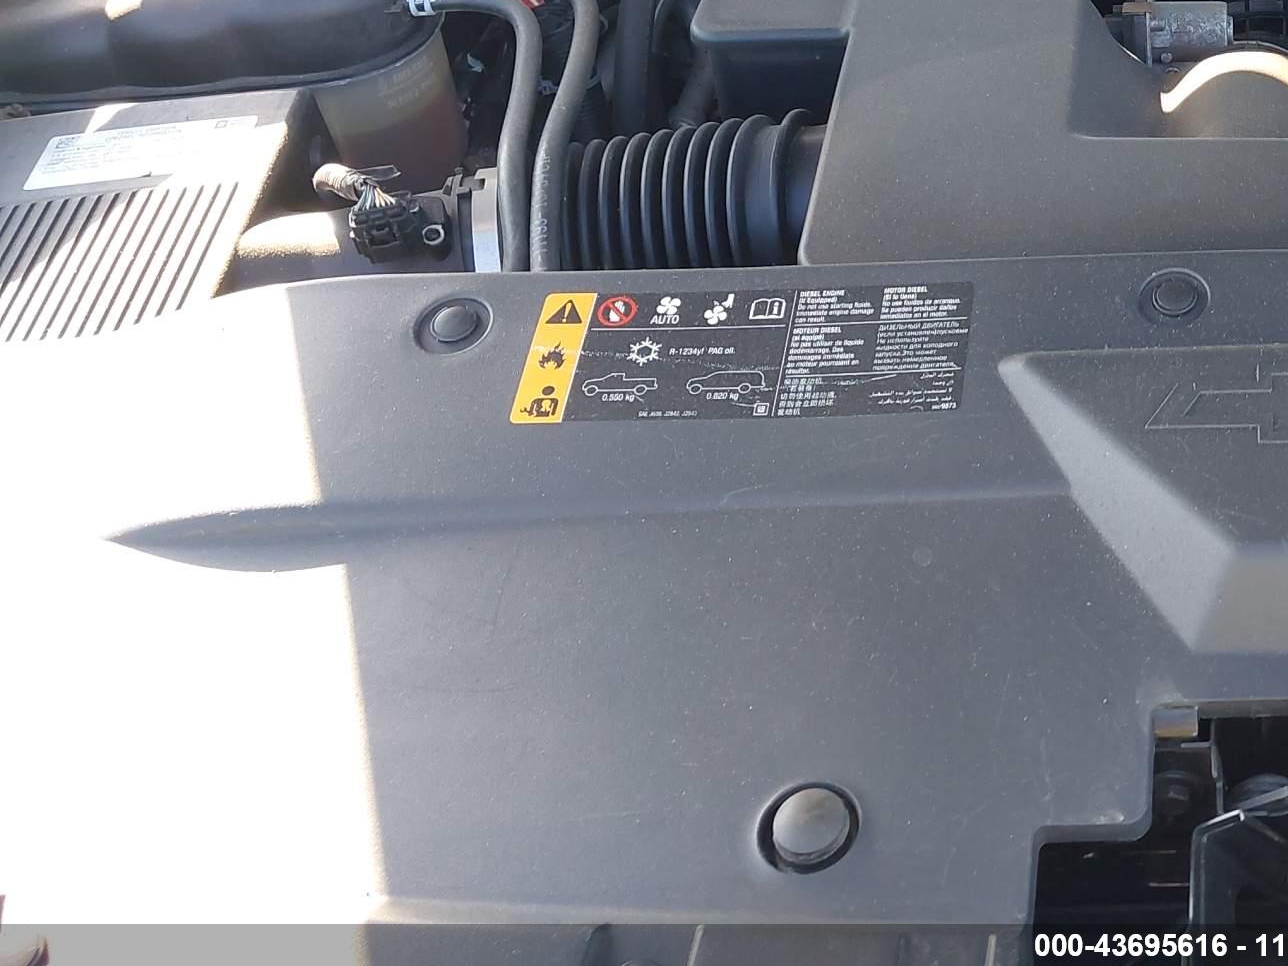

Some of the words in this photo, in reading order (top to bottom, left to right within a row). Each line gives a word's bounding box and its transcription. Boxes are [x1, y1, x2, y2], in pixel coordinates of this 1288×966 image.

[822, 289, 845, 297] ENGINE
[907, 286, 929, 294] DIESEL
[830, 302, 853, 310] starting
[881, 306, 889, 314] Se
[889, 306, 913, 314] pueden
[913, 305, 938, 313] producir
[828, 309, 849, 317] engine
[849, 308, 875, 316] damage
[650, 314, 680, 325] AUTO
[921, 321, 960, 330] ДВИГАТЕЛЬ
[793, 327, 820, 335] MOTEUR
[820, 326, 842, 334] DIESEL
[708, 347, 723, 355] PAG
[625, 393, 635, 403] kg
[729, 392, 739, 401] kg
